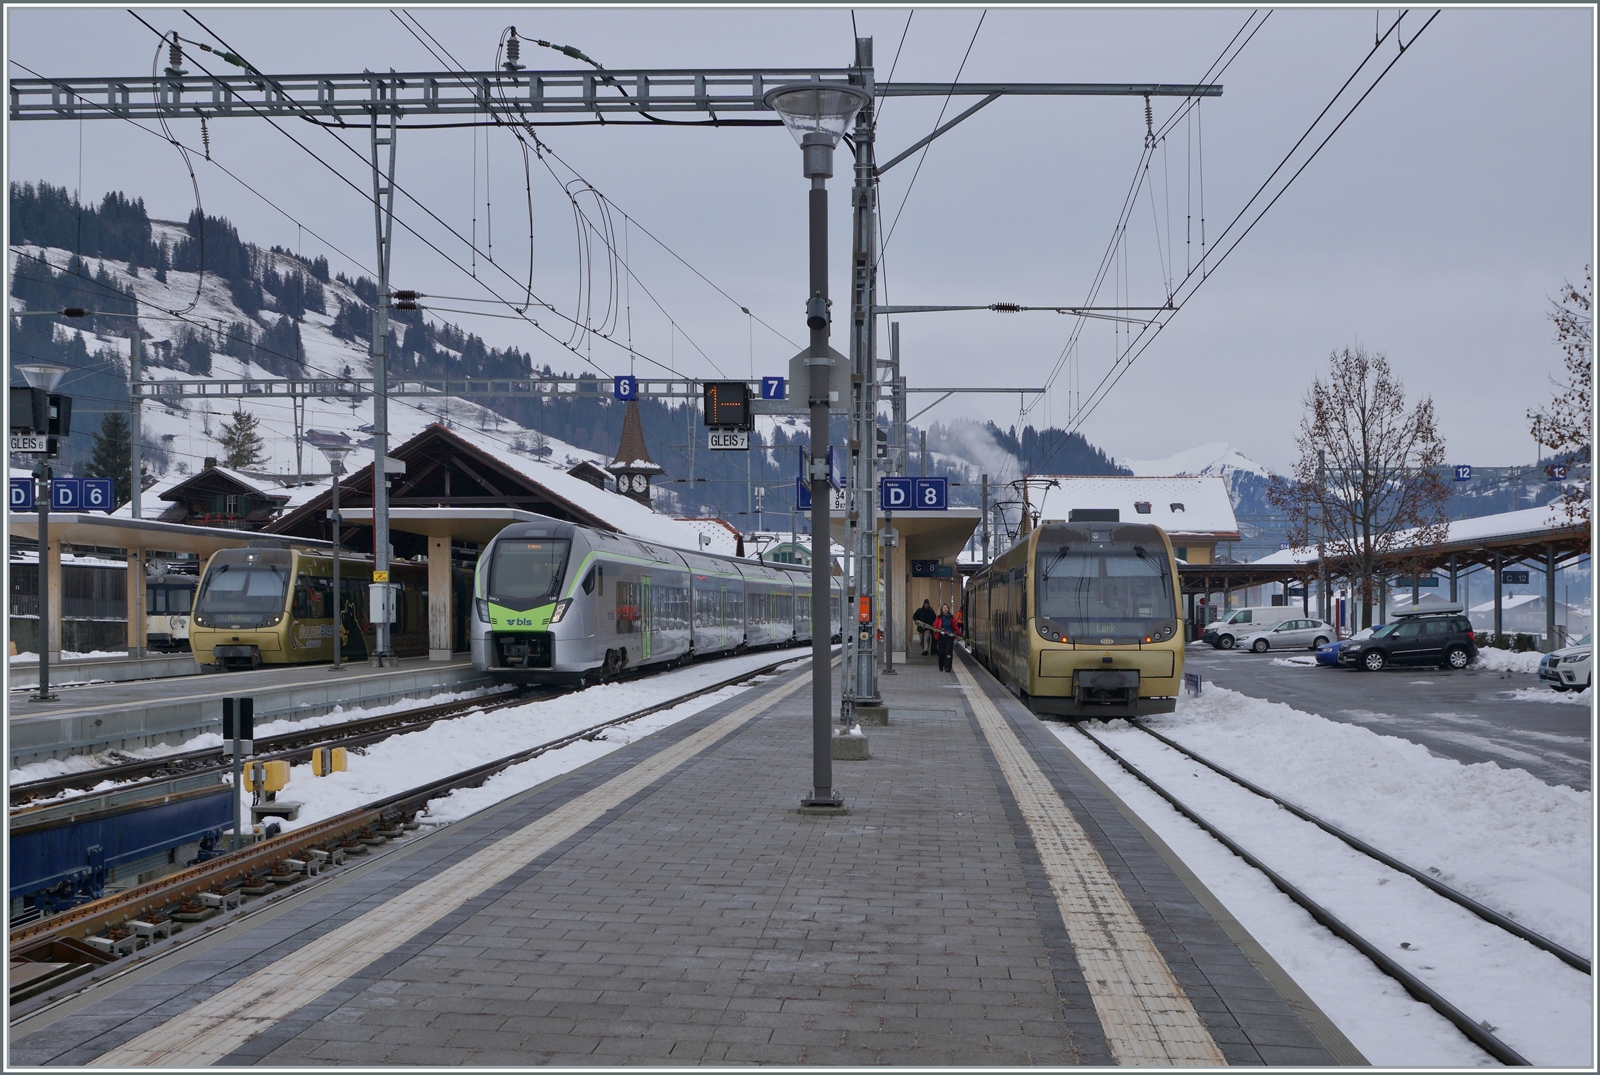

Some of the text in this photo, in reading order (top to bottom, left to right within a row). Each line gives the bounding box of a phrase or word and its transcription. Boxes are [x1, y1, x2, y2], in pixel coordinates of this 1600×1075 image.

[619, 379, 630, 396] 6
[767, 380, 779, 397] 7
[11, 438, 37, 449] GLEIS
[711, 435, 745, 447] GLEIS 7
[1458, 467, 1470, 478] 12
[11, 488, 25, 504] D
[60, 488, 103, 504] D 6
[891, 488, 937, 504] D 8
[1506, 574, 1527, 582] C 12
[516, 618, 532, 626] bls
[1096, 622, 1116, 633] Lenk
